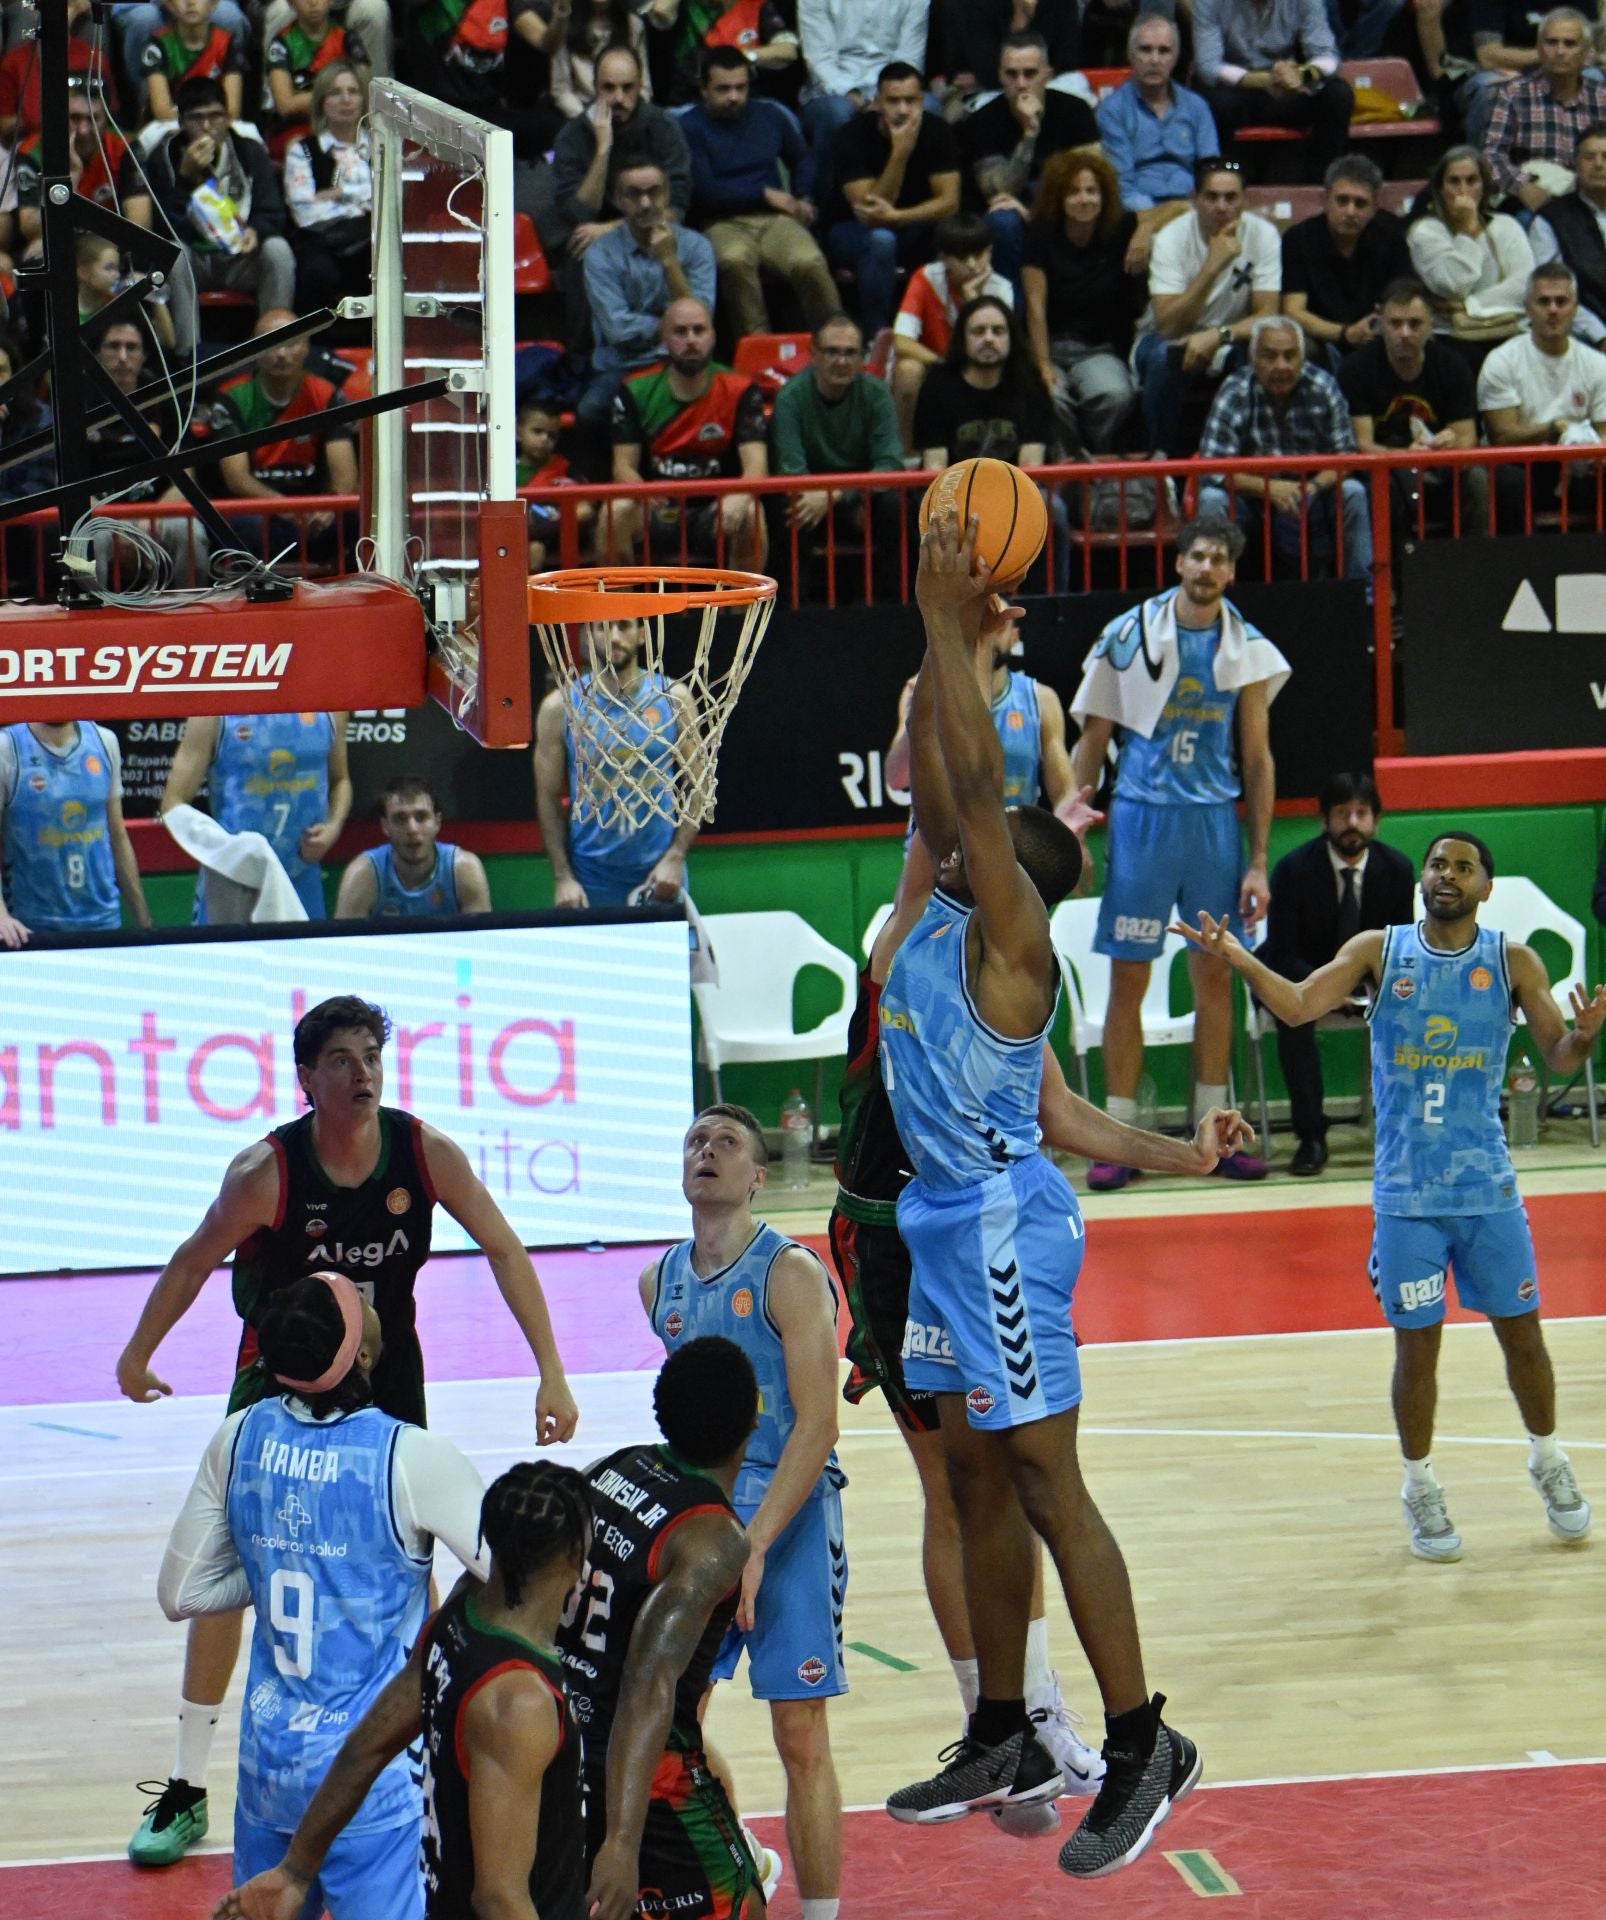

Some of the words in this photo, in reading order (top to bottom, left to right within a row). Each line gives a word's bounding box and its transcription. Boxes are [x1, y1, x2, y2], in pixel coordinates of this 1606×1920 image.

[89, 643, 293, 689] SYSTEM
[1172, 730, 1199, 764] 15
[274, 803, 290, 837] 7
[67, 854, 85, 888] 8
[1394, 1049, 1484, 1071] agropal
[1424, 1083, 1446, 1124] 2
[259, 1438, 340, 1483] KAMBA
[636, 1502, 668, 1530] JR
[310, 1541, 347, 1558] salud
[270, 1568, 315, 1680] 9
